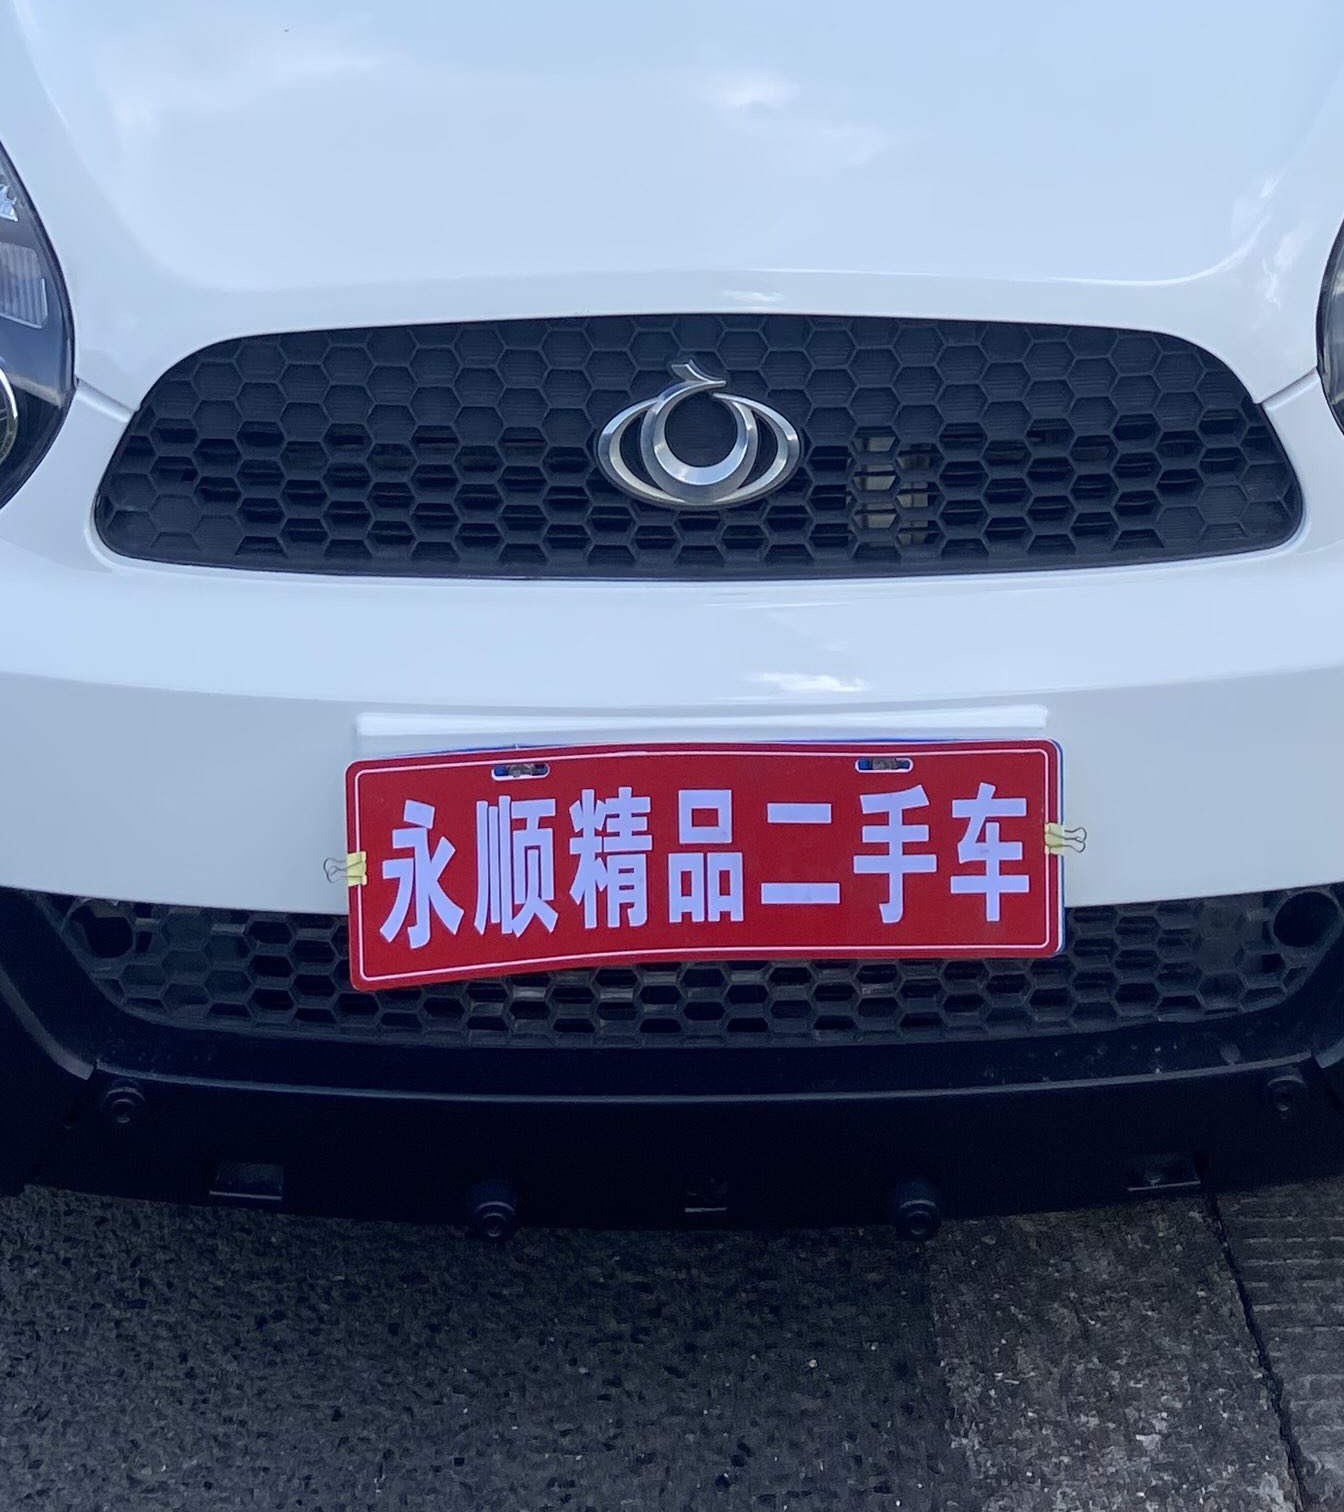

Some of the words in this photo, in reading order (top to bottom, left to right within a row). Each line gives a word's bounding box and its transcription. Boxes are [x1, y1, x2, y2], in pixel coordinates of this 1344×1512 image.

[380, 782, 1029, 949] 永顺精品二手车
